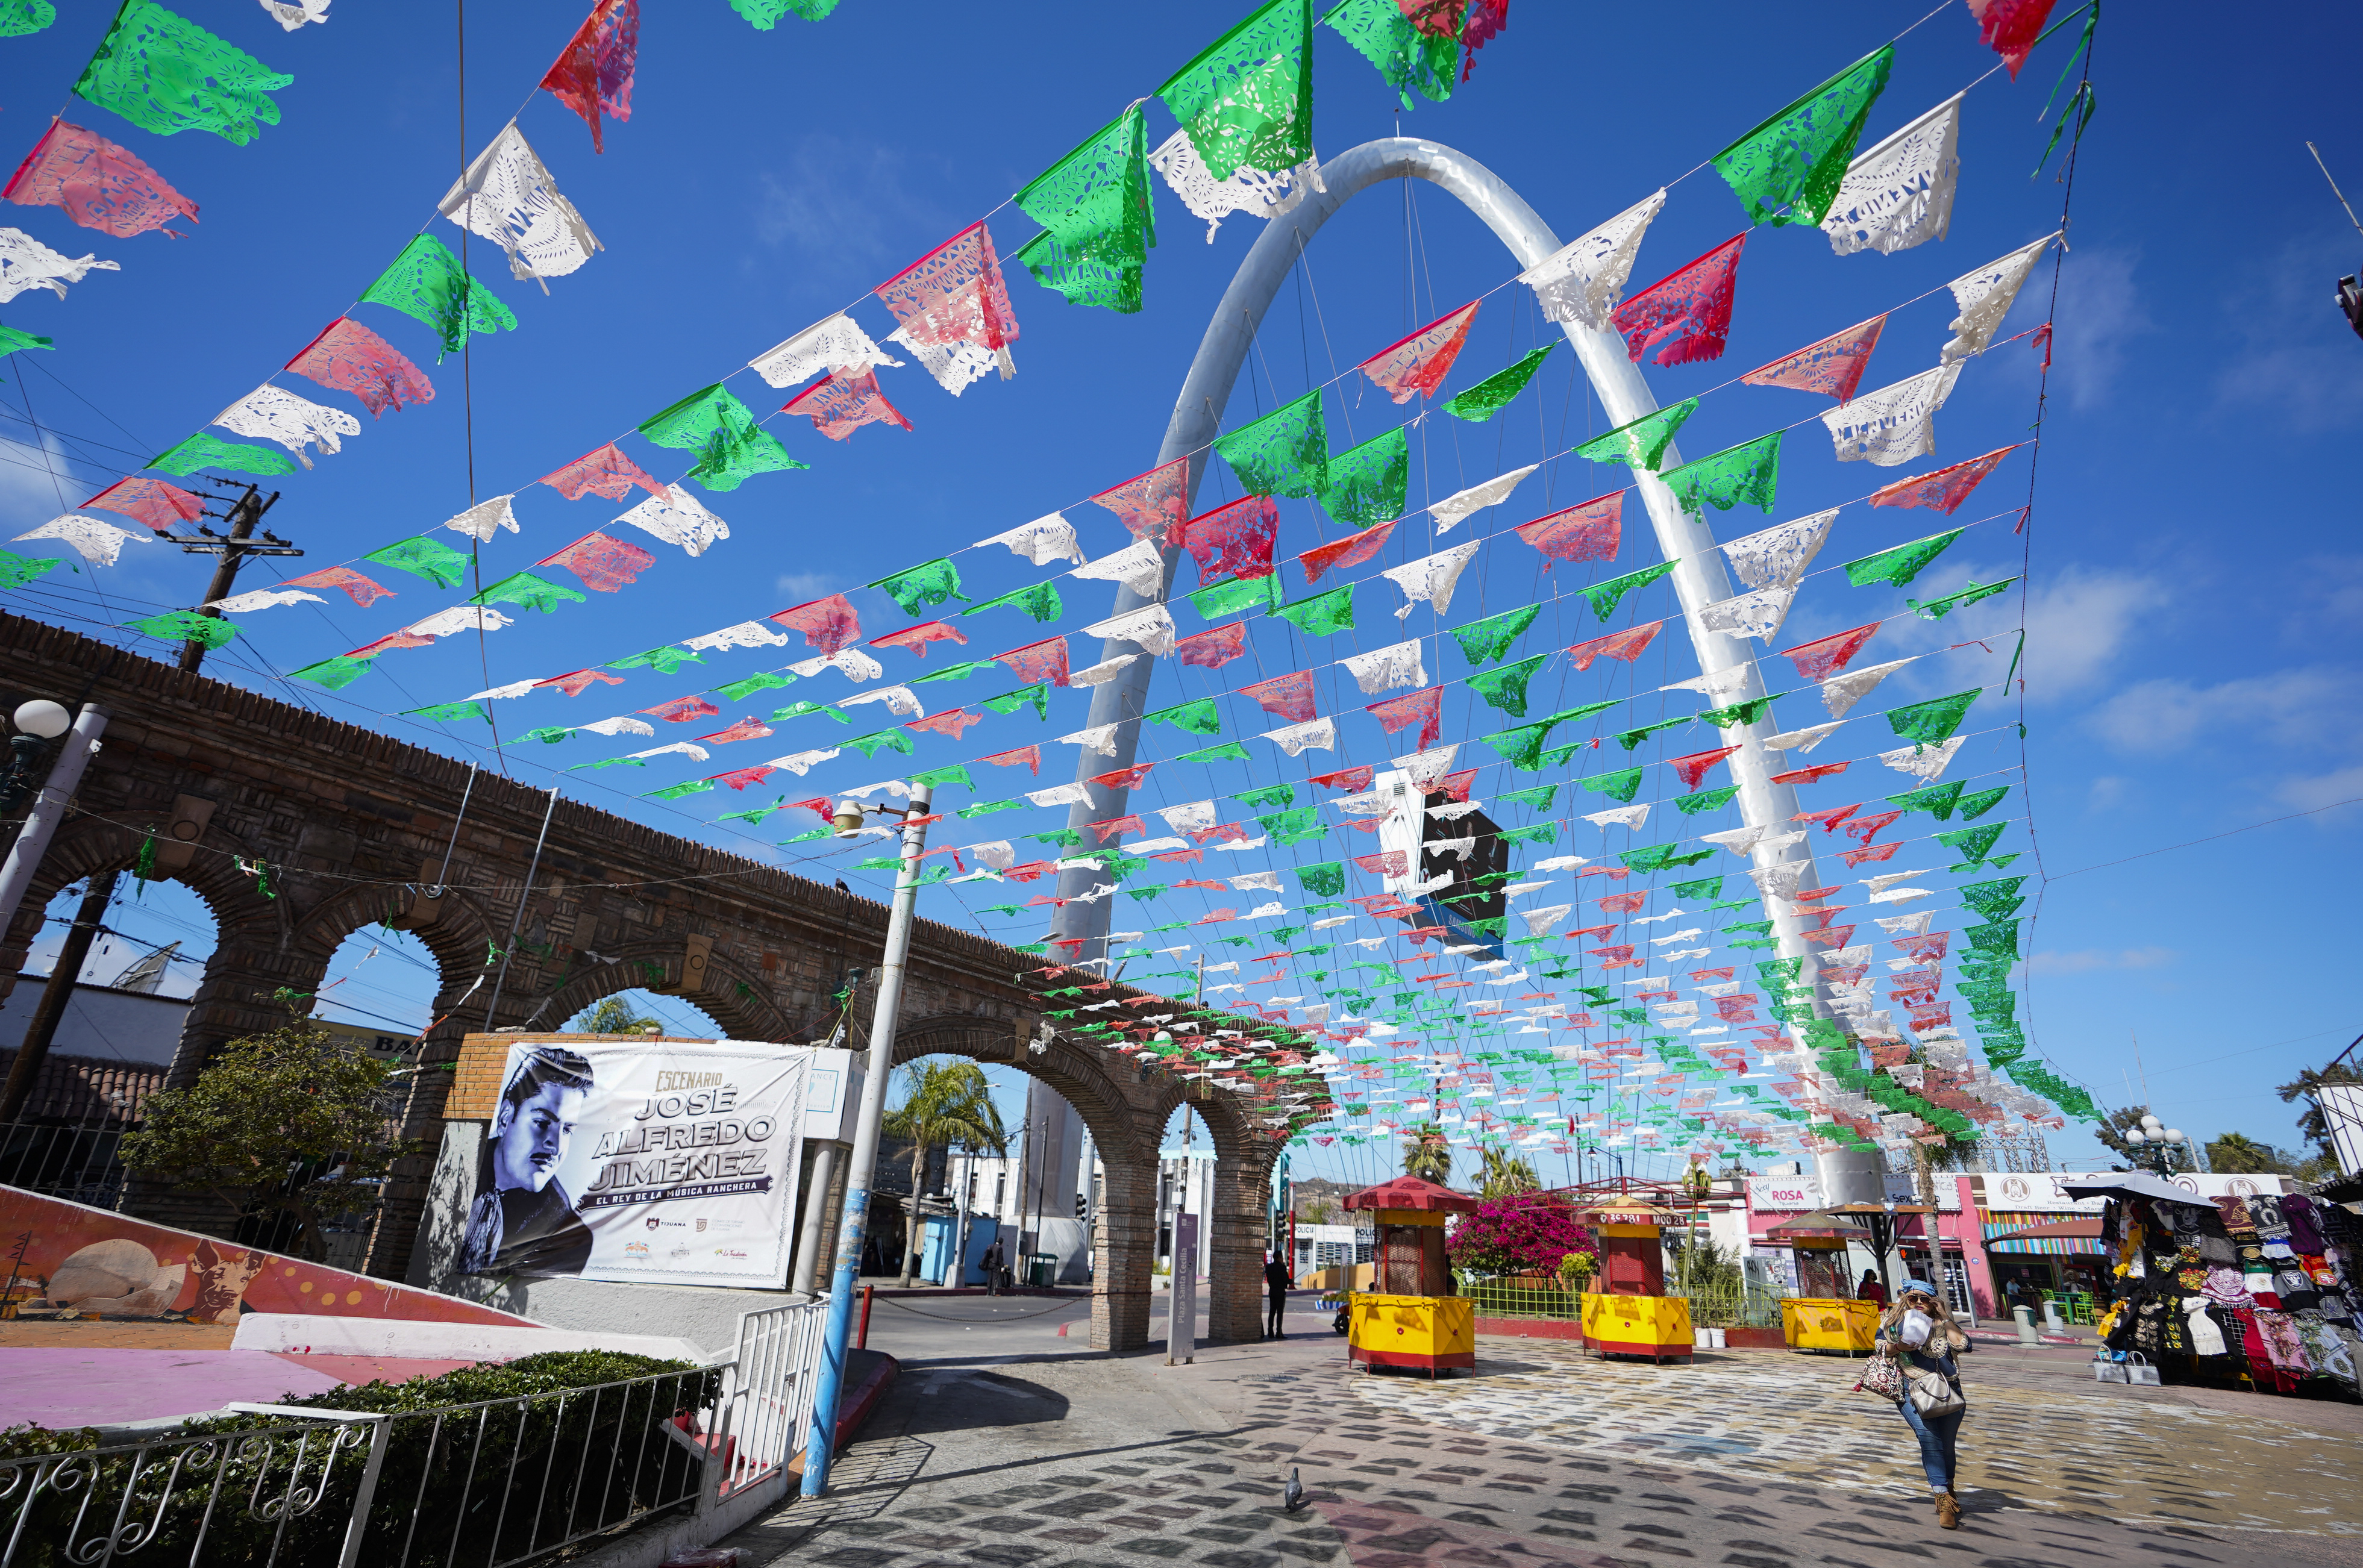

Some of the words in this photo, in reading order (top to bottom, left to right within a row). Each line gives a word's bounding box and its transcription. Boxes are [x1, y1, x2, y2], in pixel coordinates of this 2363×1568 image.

[374, 1036, 423, 1056] BA
[656, 1070, 722, 1092] ESCENARIO
[634, 1083, 737, 1121] JOSÉ
[591, 1115, 777, 1160] ALFREDO
[587, 1148, 768, 1192] JIMÉNEZ
[612, 1195, 631, 1204] REY
[634, 1193, 648, 1201] DE
[651, 1190, 662, 1199] LA
[666, 1187, 703, 1198] MÚSICA
[707, 1181, 757, 1194] RANCHERA
[1754, 1184, 1770, 1193] Sexy
[1772, 1190, 1804, 1201] ROSA
[1892, 1193, 1911, 1202] Sex
[1610, 1213, 1621, 1221] ZC
[1653, 1214, 1671, 1225] MOD
[1674, 1216, 1685, 1226] 28
[1356, 1228, 1376, 1237] POLIC
[1177, 1301, 1186, 1324] Plaza
